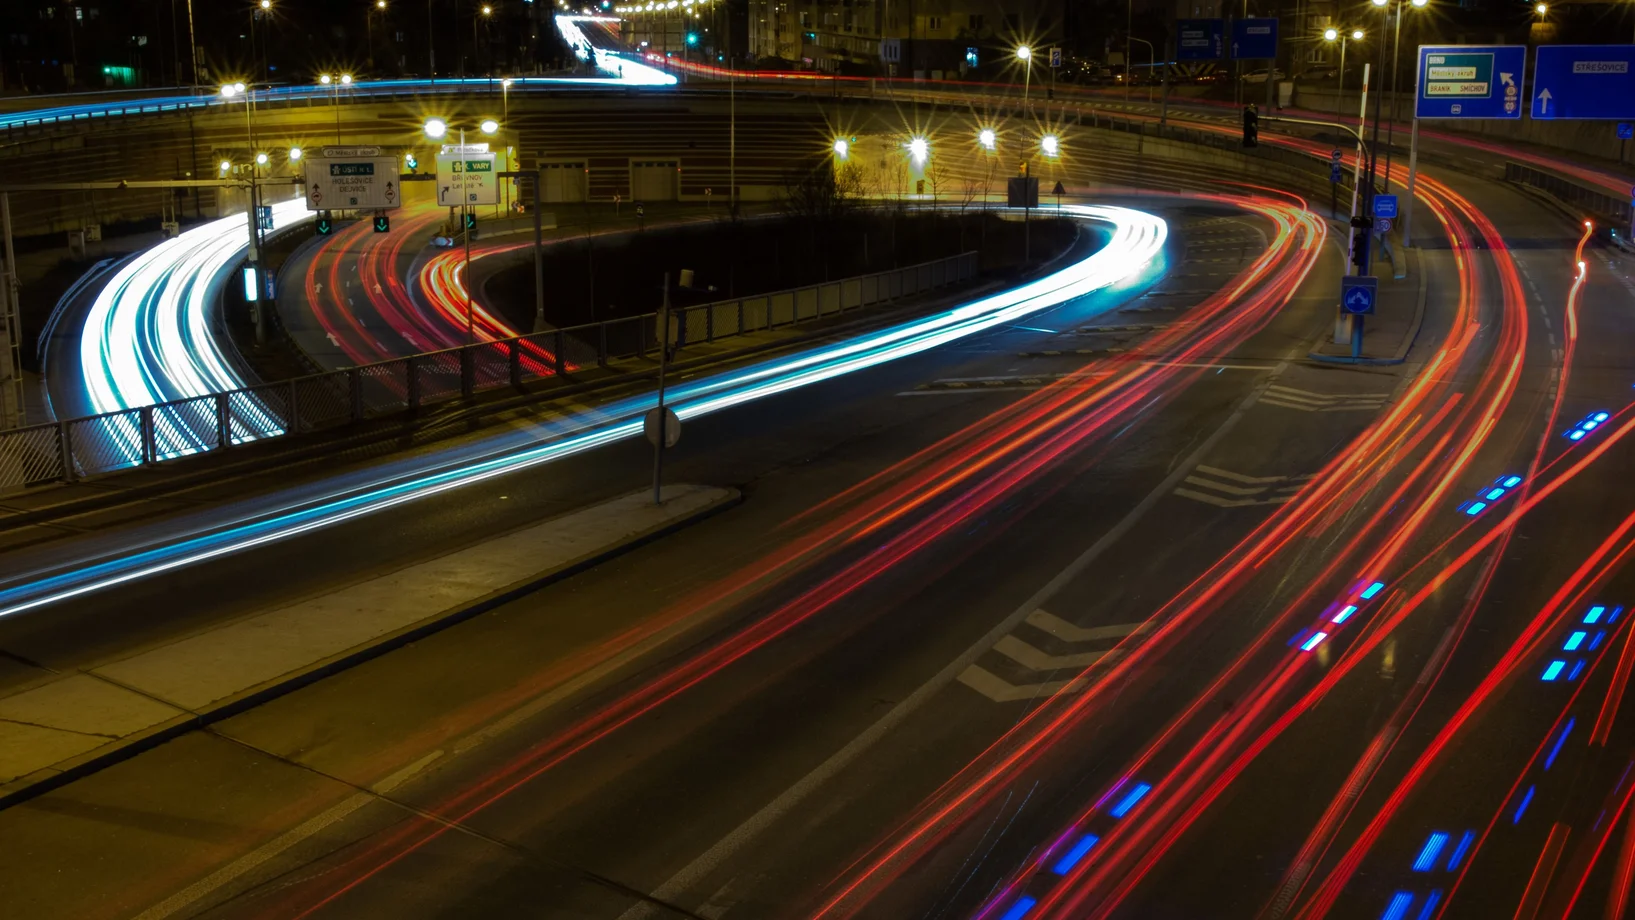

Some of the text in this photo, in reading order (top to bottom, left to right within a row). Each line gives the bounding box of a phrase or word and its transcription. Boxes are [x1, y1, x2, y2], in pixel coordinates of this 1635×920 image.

[1575, 63, 1626, 72] STŘEŠOVICE
[1430, 84, 1486, 92] BRANÍK SMÍCHOV
[332, 177, 373, 185] HOLEŠOVICE
